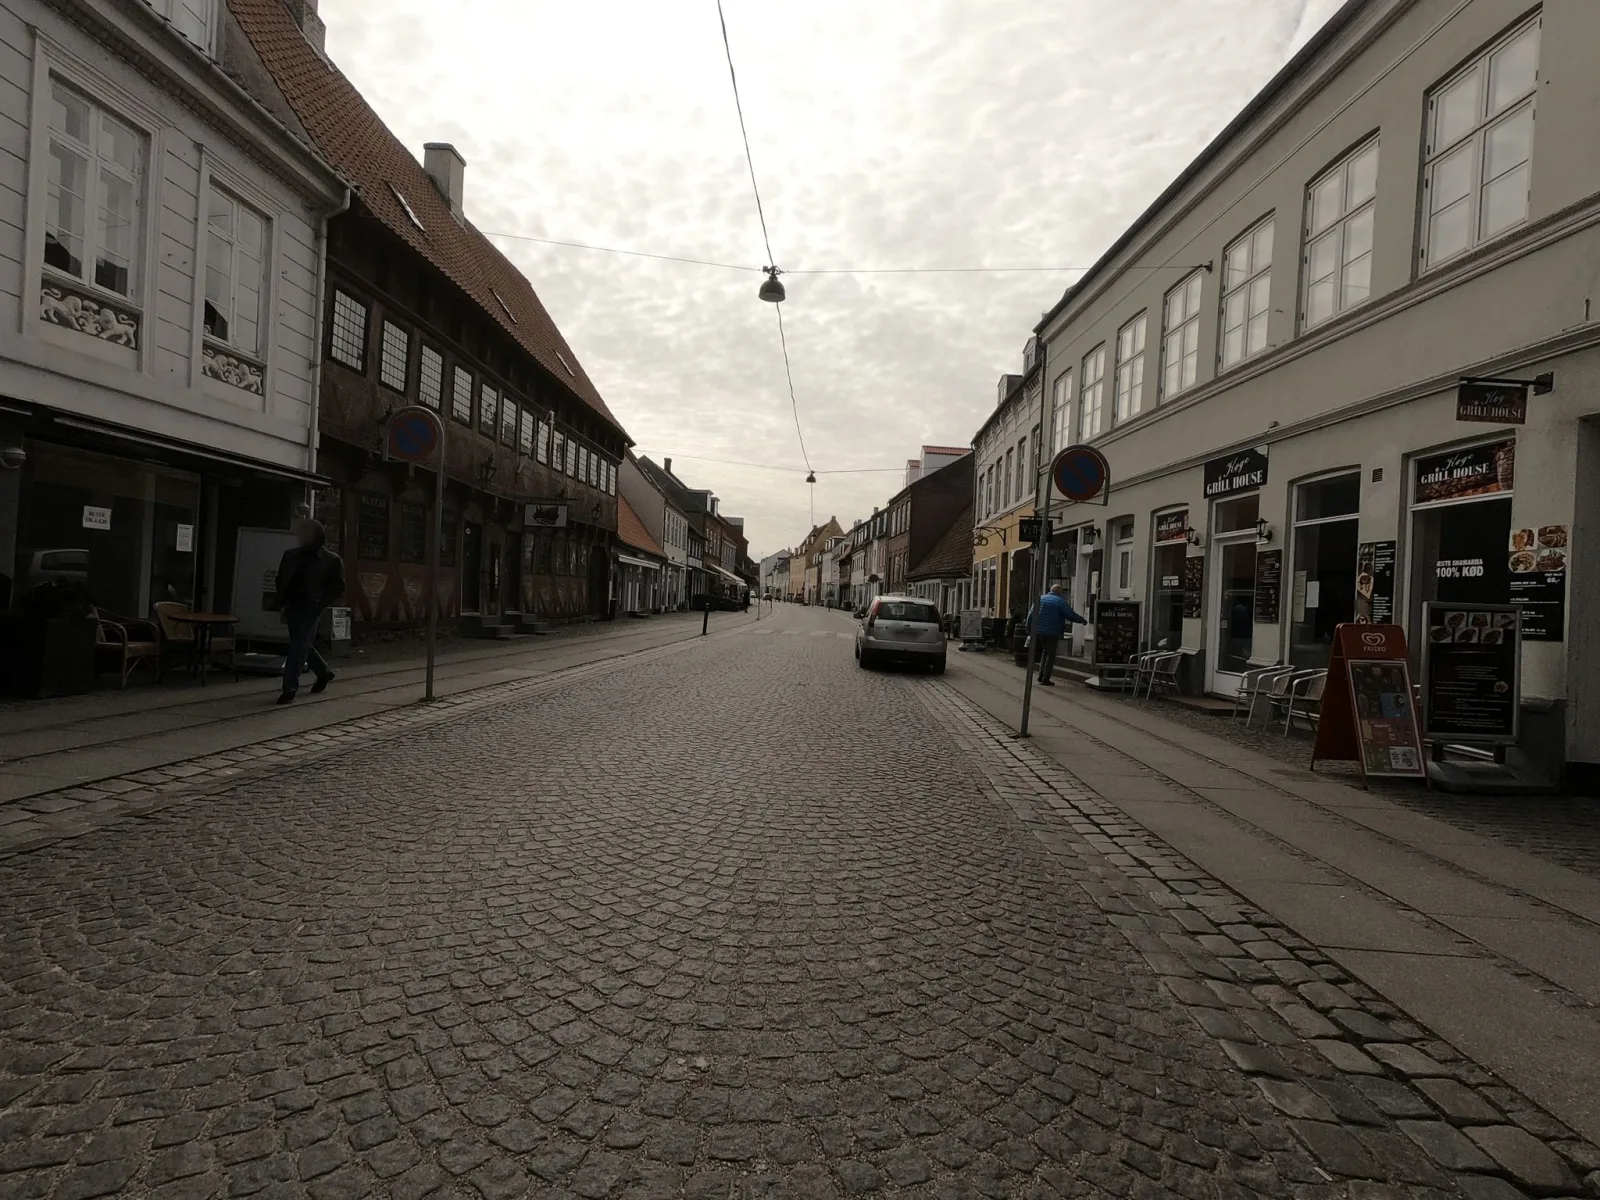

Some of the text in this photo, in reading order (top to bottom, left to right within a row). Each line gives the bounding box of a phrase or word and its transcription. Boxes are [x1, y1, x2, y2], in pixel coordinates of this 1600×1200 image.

[1453, 463, 1490, 479] HOUSE
[1232, 470, 1263, 489] HOUSE
[1435, 565, 1484, 578] 100% KØD
